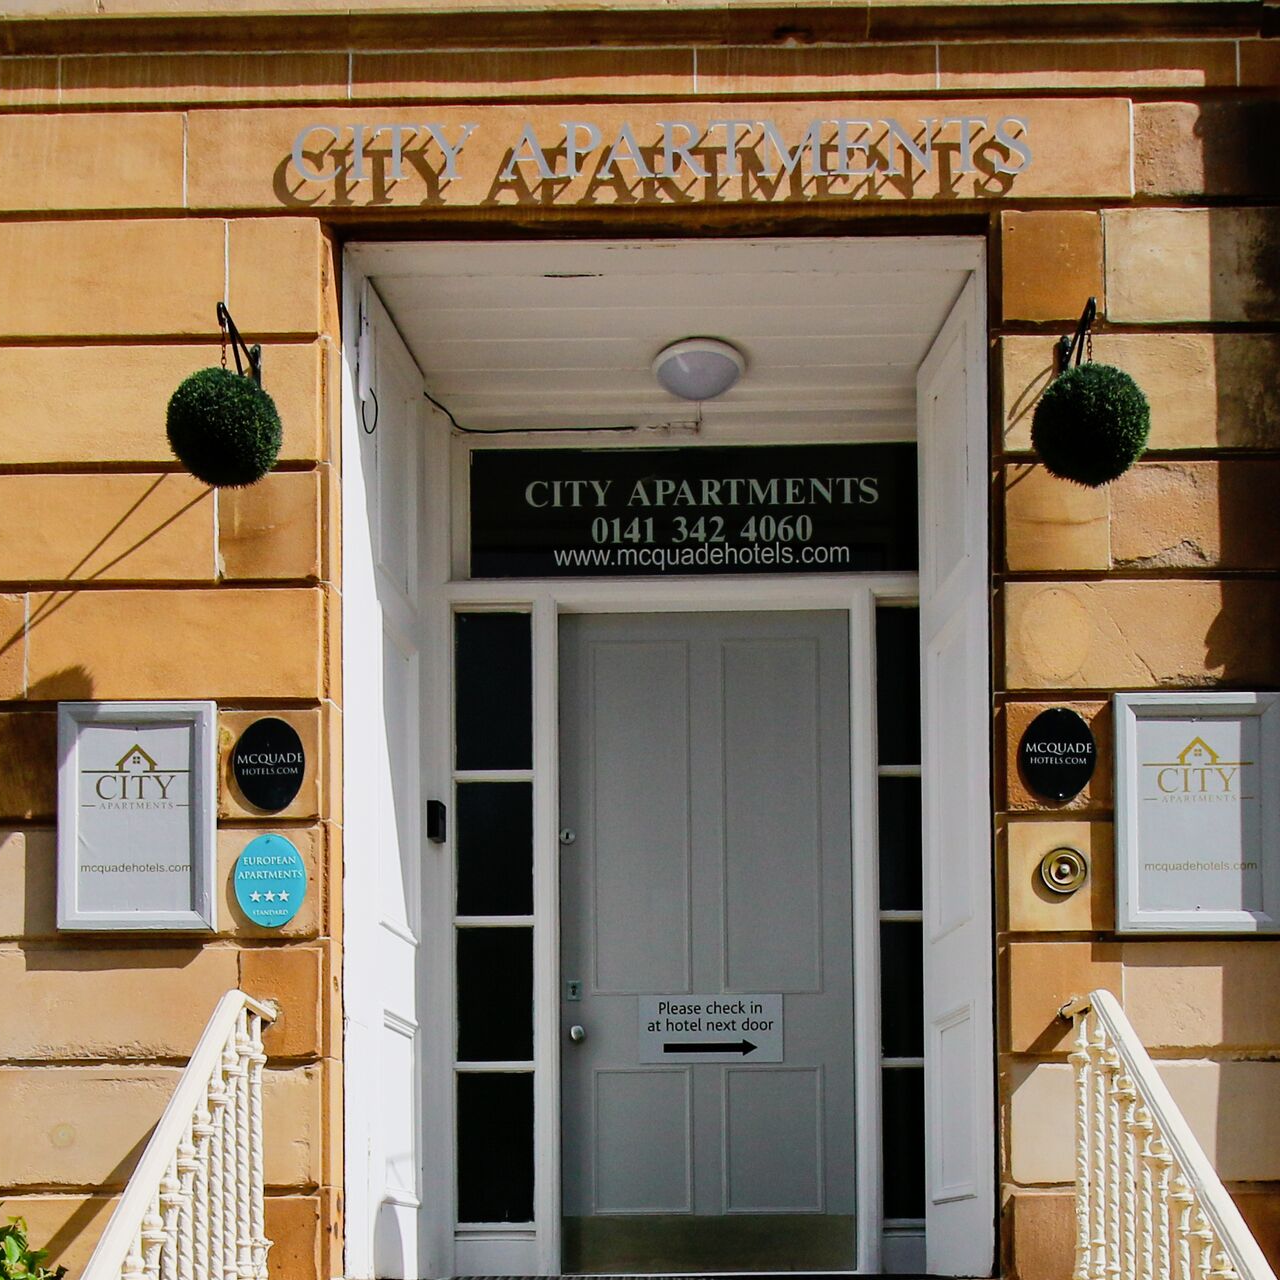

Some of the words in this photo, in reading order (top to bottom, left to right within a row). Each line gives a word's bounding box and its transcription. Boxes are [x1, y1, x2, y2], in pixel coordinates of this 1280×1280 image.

[292, 121, 480, 182] CITY
[498, 114, 1033, 180] APARTMENTS
[524, 479, 614, 508] CITY
[626, 476, 880, 507] APARTMENTS
[591, 515, 657, 545] 0141
[671, 515, 727, 544] 342
[739, 513, 814, 543] 4060
[553, 540, 851, 572] www.mcquadehotels.com
[1025, 742, 1093, 756] MCQUADE
[237, 752, 304, 766] MCQUADE
[95, 774, 177, 801] CITY
[1157, 767, 1238, 794] CITY
[98, 801, 175, 811] APARTMENTS
[242, 855, 297, 866] EUROPEAN
[1143, 860, 1259, 873] mcquadehotels.com
[79, 862, 193, 875] mcquadehotels.com
[237, 869, 304, 880] APARTMENTS
[658, 1001, 702, 1016] Please
[705, 1000, 746, 1015] check
[750, 1000, 763, 1014] in
[647, 1020, 661, 1032] at
[666, 1018, 702, 1032] hotel
[706, 1019, 738, 1031] next
[741, 1017, 774, 1031] door
